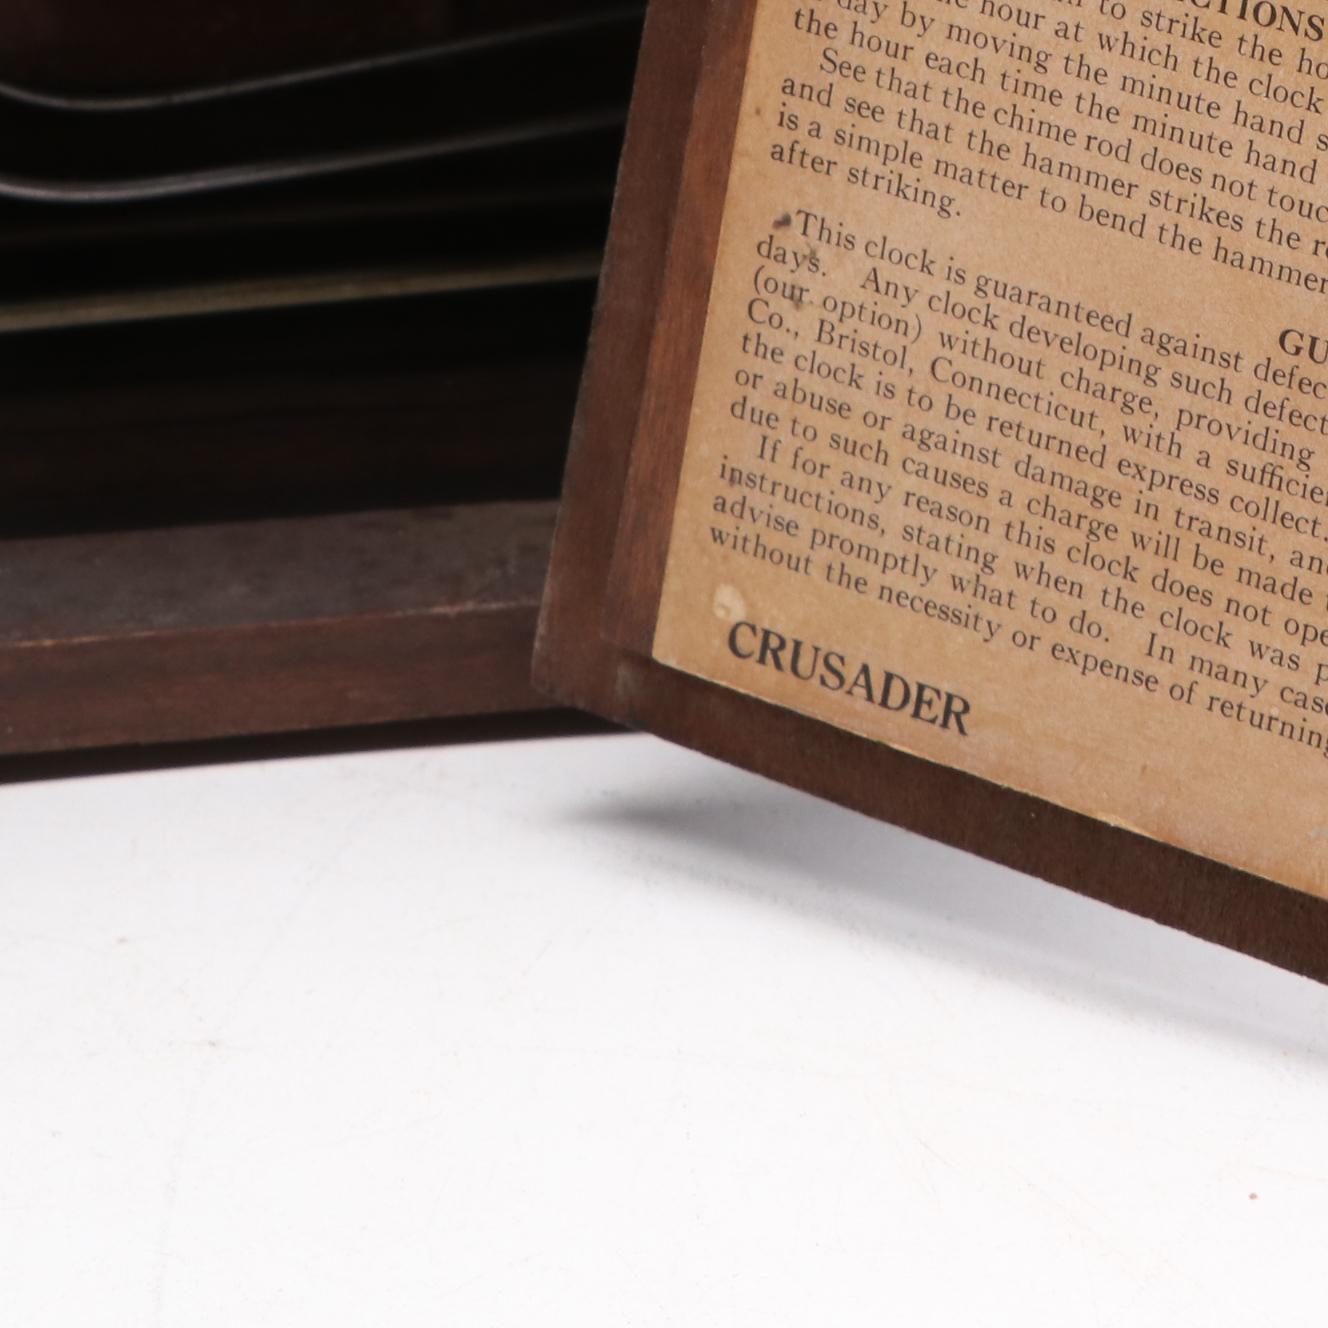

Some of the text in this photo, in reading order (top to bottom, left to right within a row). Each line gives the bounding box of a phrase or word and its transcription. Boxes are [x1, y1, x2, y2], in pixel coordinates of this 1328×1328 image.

[793, 7, 839, 40] the
[848, 20, 915, 62] hour
[924, 51, 986, 86] each
[999, 68, 1064, 108] time
[1074, 91, 1121, 125] the
[1131, 112, 1234, 159] minute
[1244, 138, 1318, 186] hand
[1053, 20, 1084, 43] at
[1097, 30, 1179, 73] which
[1192, 55, 1238, 89] the
[1247, 72, 1324, 115] clock
[769, 139, 961, 220] after striking.
[746, 297, 799, 340] Co.,
[815, 317, 913, 377] Bristol,
[929, 356, 1105, 438] Connecticut,
[1122, 423, 1182, 460] with
[1195, 449, 1211, 470] a
[729, 395, 780, 431] due
[790, 417, 818, 442] to
[828, 432, 889, 467] such
[901, 456, 989, 499] causes
[998, 489, 1013, 509] a
[1026, 493, 1119, 543] charge
[1131, 530, 1181, 562] will
[1192, 542, 1225, 577] be
[1235, 566, 1313, 606] made
[712, 495, 800, 537] advise
[809, 527, 938, 588] promptly
[950, 573, 1016, 611] what
[1029, 597, 1057, 624] to
[1068, 609, 1110, 643] do.
[1144, 631, 1175, 665] In
[1188, 654, 1269, 699] many
[726, 620, 971, 737] CRUSADER
